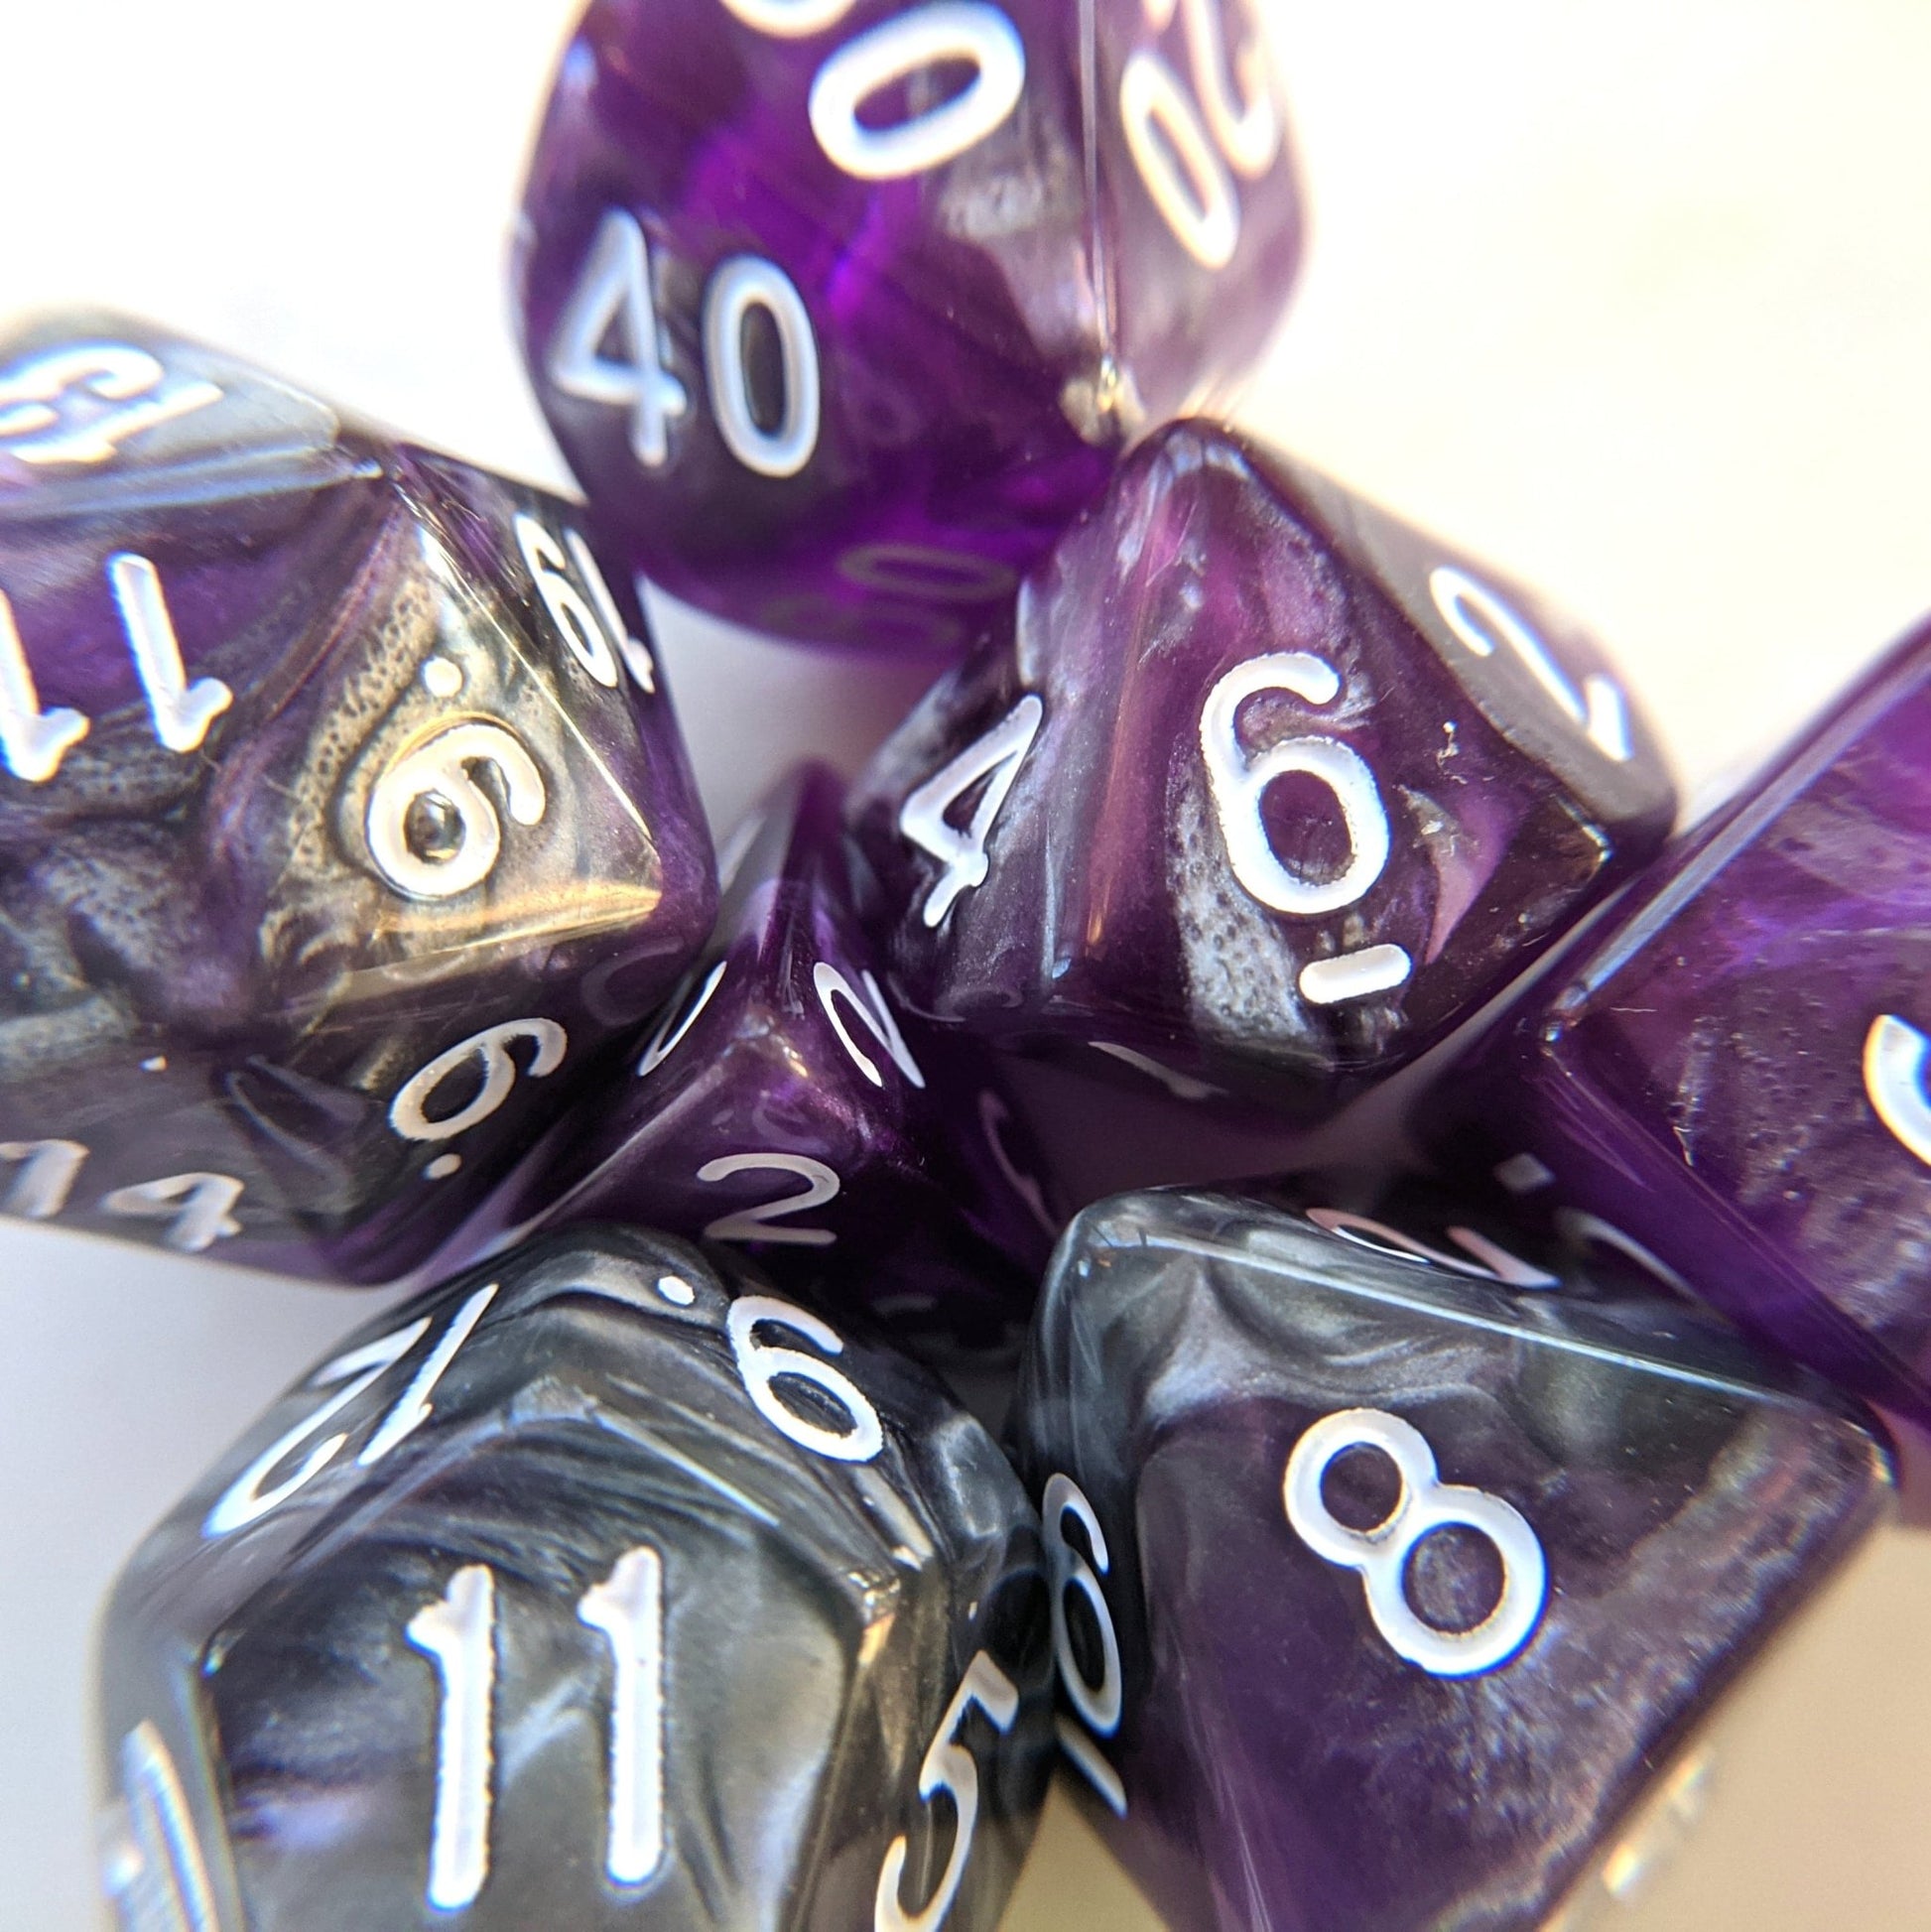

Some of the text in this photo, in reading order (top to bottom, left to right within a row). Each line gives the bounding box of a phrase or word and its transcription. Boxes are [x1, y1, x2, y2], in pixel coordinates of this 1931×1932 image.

[544, 206, 822, 478] 40
[0, 549, 234, 785] 11
[514, 513, 657, 696] 19
[899, 694, 1044, 930] 4
[0, 1137, 246, 1253] 14
[696, 1151, 842, 1243] 2
[201, 1282, 499, 1537] 12
[1284, 1405, 1548, 1679] 8
[405, 1544, 667, 1917] 11
[873, 1648, 1020, 1932] 5
